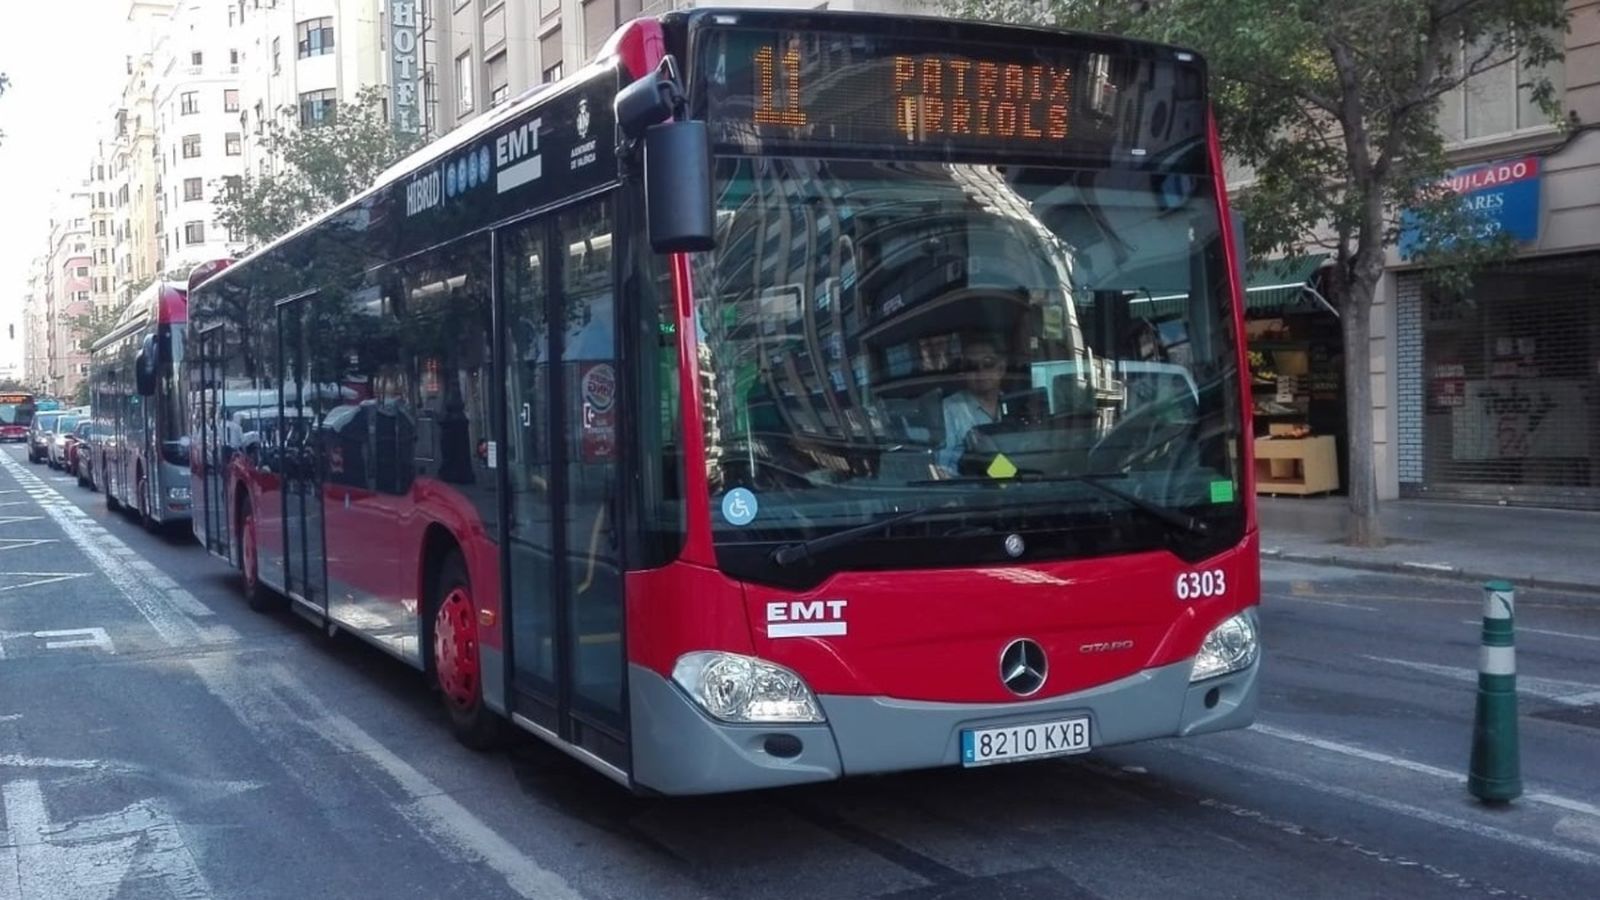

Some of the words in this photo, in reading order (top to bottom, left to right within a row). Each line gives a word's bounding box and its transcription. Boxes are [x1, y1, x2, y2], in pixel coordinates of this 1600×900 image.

[393, 2, 417, 133] HOTEL
[753, 45, 807, 126] 11
[896, 56, 1071, 101] PATRAIX
[496, 117, 542, 168] EMT
[406, 171, 440, 217] HÍBRID
[1176, 569, 1226, 600] 6303
[767, 600, 847, 621] EMT
[1080, 640, 1134, 653] CITARO
[980, 729, 1037, 757] 8210
[1045, 723, 1084, 750] KXB
